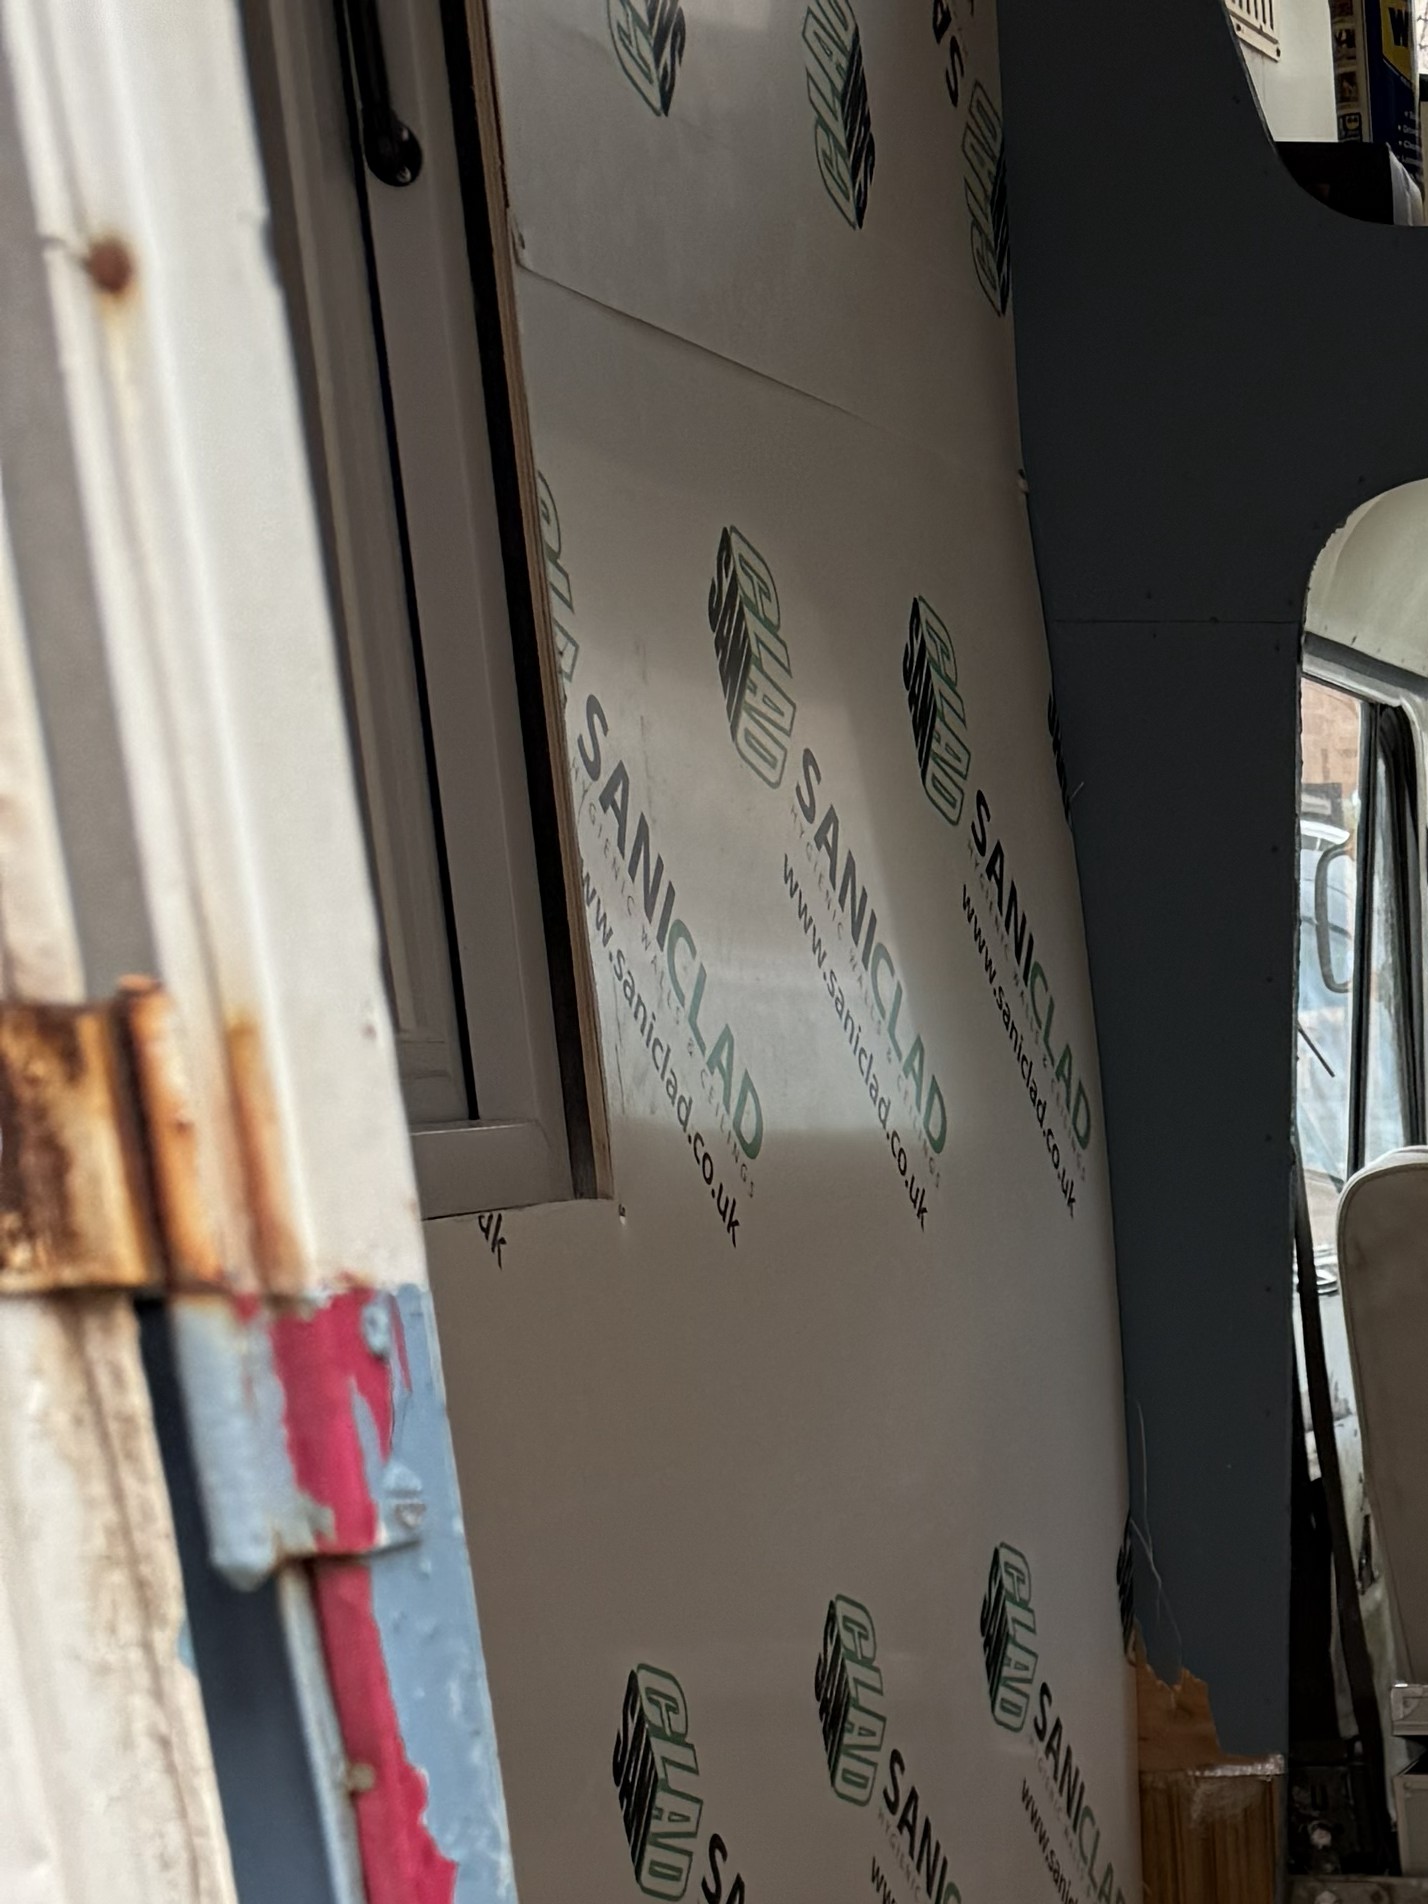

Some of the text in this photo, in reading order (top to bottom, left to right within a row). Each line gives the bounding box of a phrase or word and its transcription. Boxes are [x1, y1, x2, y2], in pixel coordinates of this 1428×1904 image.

[577, 693, 764, 1160] SANICLAD
[784, 853, 928, 1233] www.saniclad.co.uk
[796, 747, 948, 1154] SANICLAD
[962, 883, 1076, 1220] www.saniclad.co.uk
[970, 789, 1091, 1150] SANICLAD
